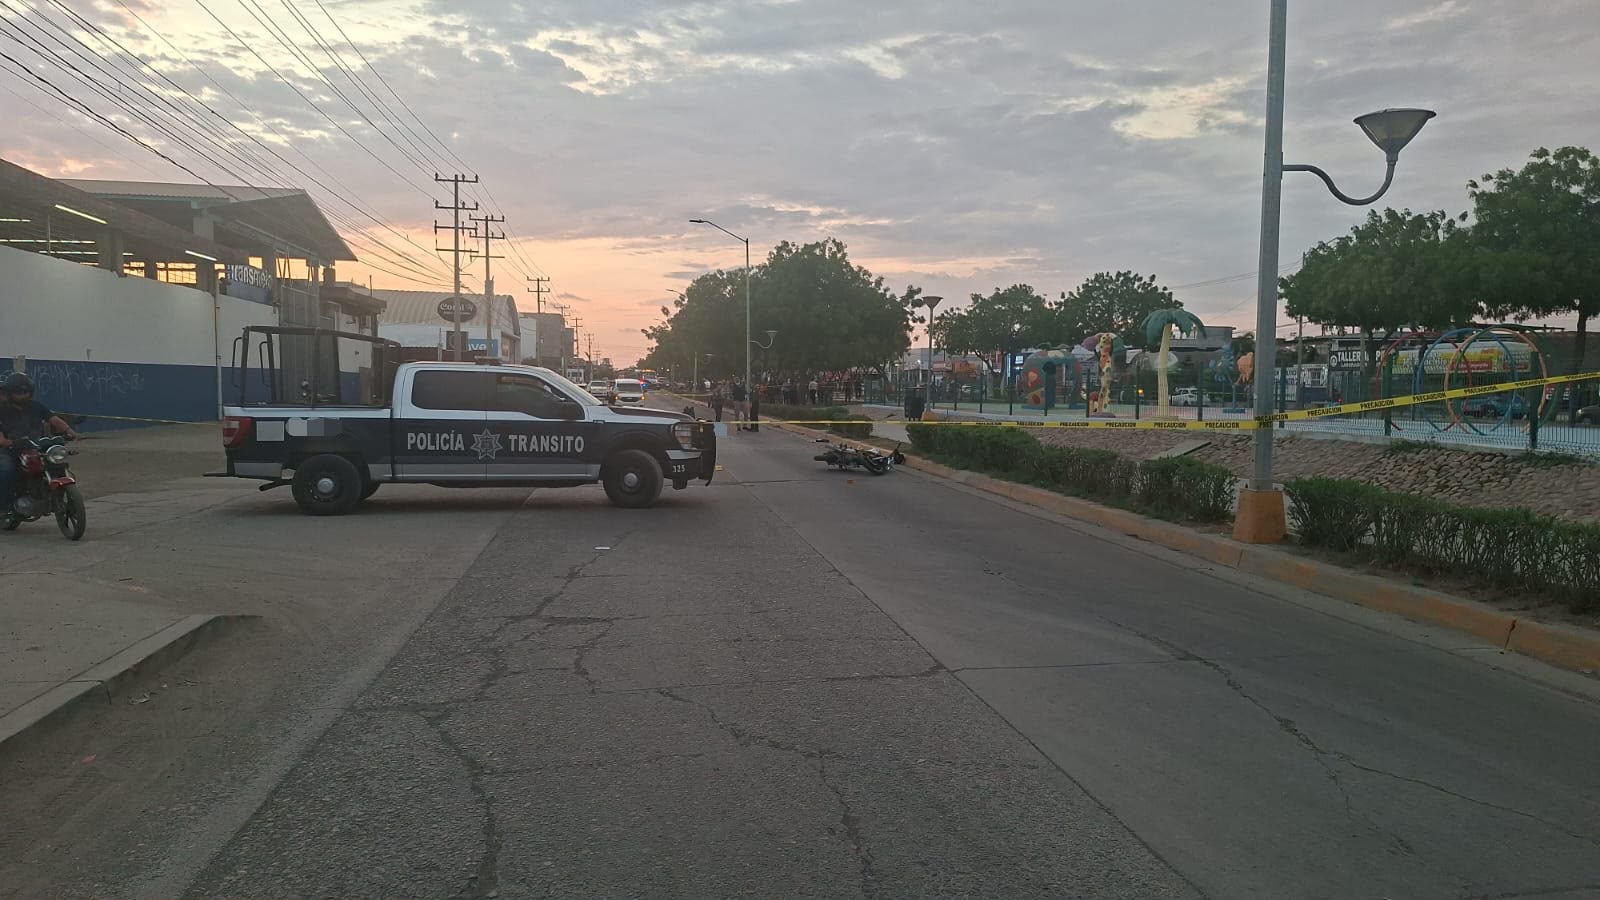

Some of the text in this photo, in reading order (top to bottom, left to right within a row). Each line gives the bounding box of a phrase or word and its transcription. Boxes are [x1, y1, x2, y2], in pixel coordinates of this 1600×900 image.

[1307, 407, 1342, 416] PRECAUCION
[1360, 400, 1394, 410] PRECAUCION
[1413, 393, 1446, 402] PRECAUCION
[407, 430, 585, 453] POLICÍA TRANSITO
